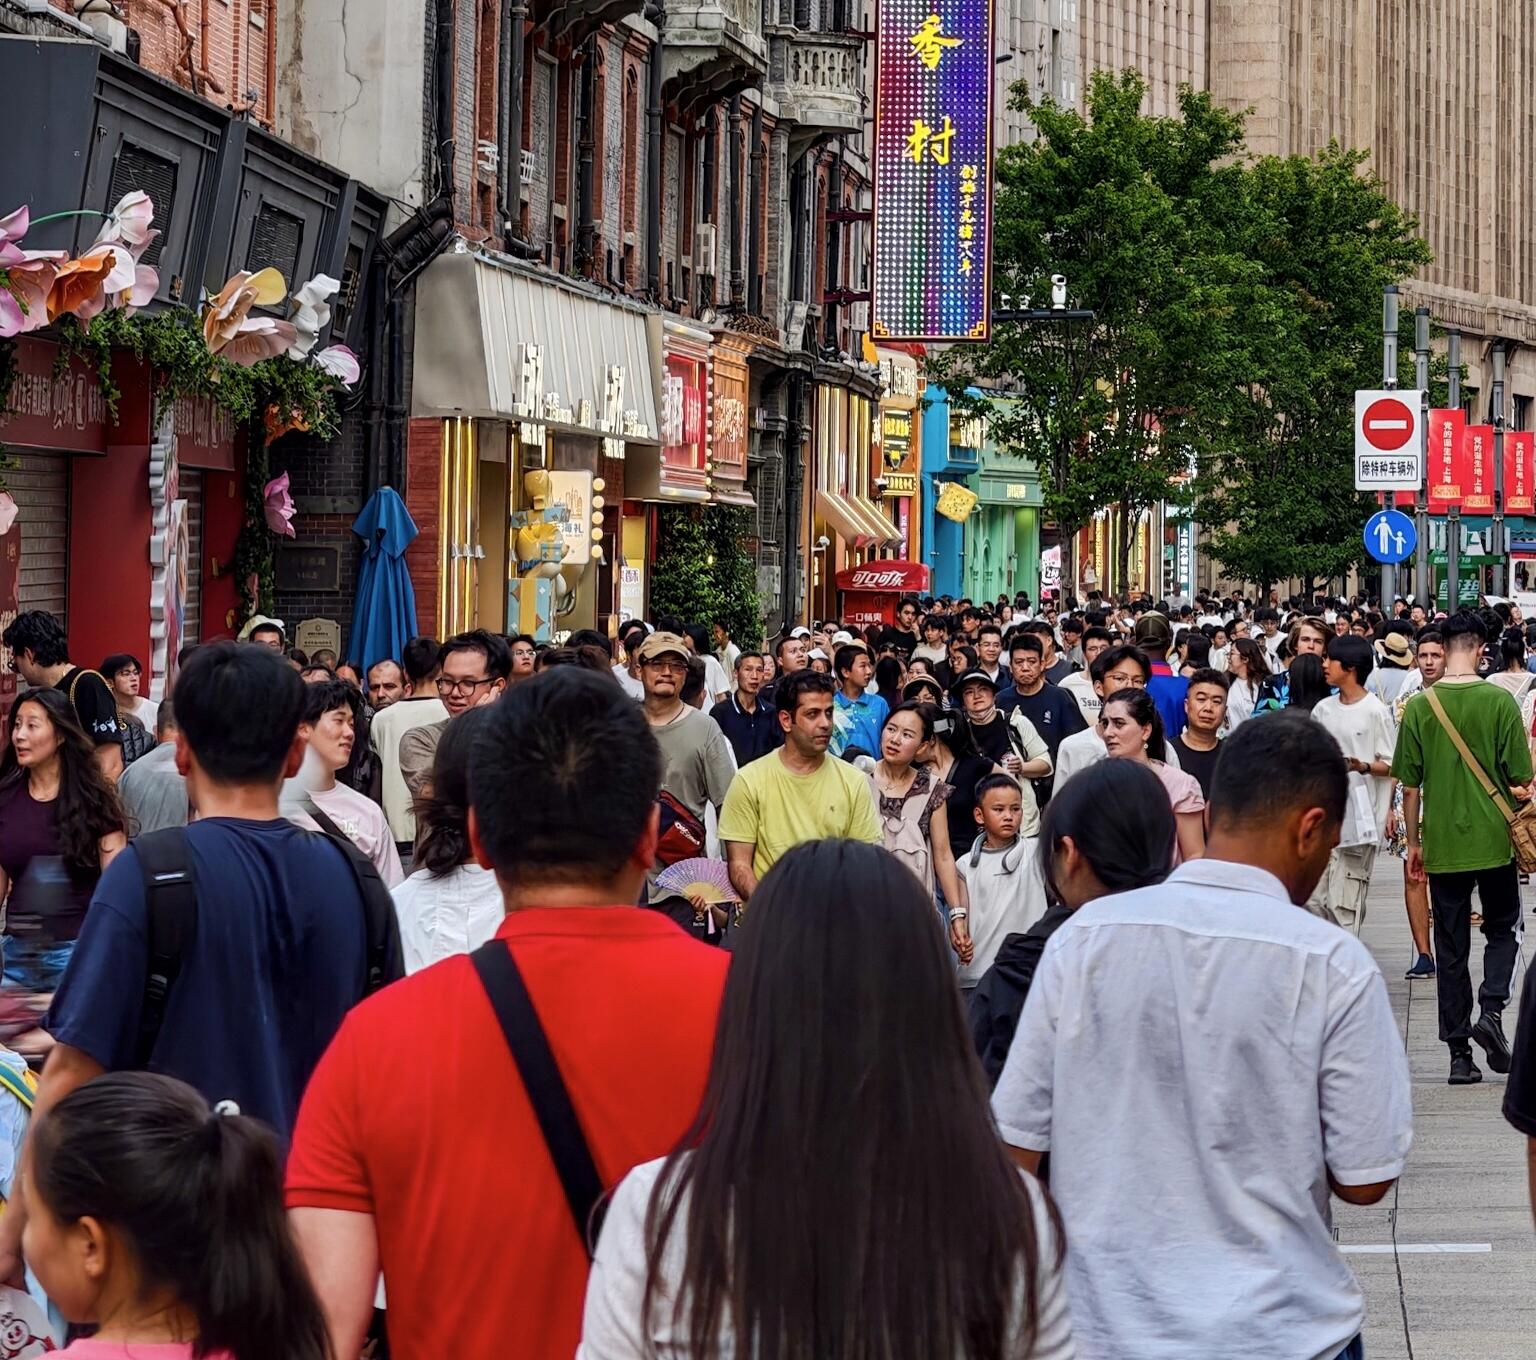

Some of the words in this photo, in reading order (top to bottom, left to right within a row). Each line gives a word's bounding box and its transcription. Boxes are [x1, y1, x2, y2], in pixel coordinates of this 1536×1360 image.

[1361, 457, 1416, 479] 除特种车辆外
[852, 570, 908, 588] 可口可乐
